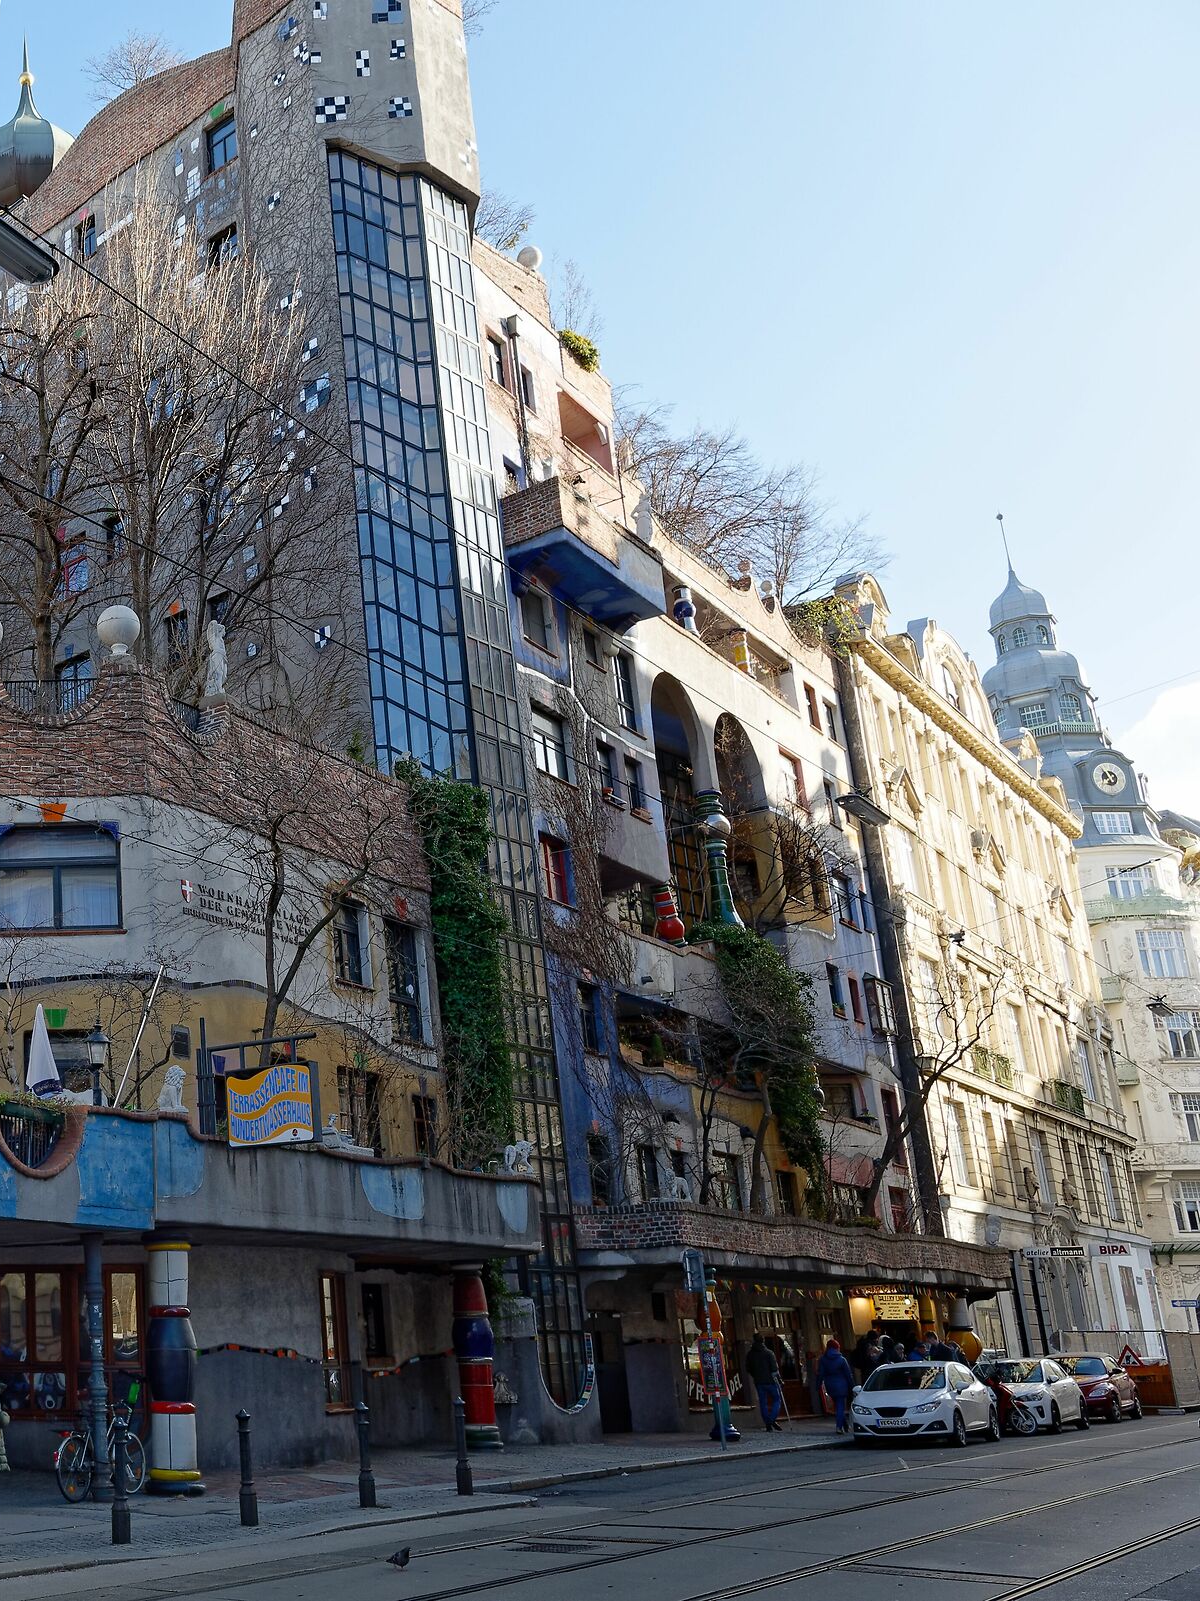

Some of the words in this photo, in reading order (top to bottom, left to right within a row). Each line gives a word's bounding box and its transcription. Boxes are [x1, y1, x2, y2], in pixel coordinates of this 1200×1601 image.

[200, 897, 222, 912] DER
[228, 1066, 297, 1114] TERRASSENCAFE
[297, 1071, 310, 1093] IM
[230, 1099, 312, 1142] HUNDERTWASSERHAUS
[1052, 1248, 1083, 1256] altmann
[1099, 1245, 1129, 1255] BIPA
